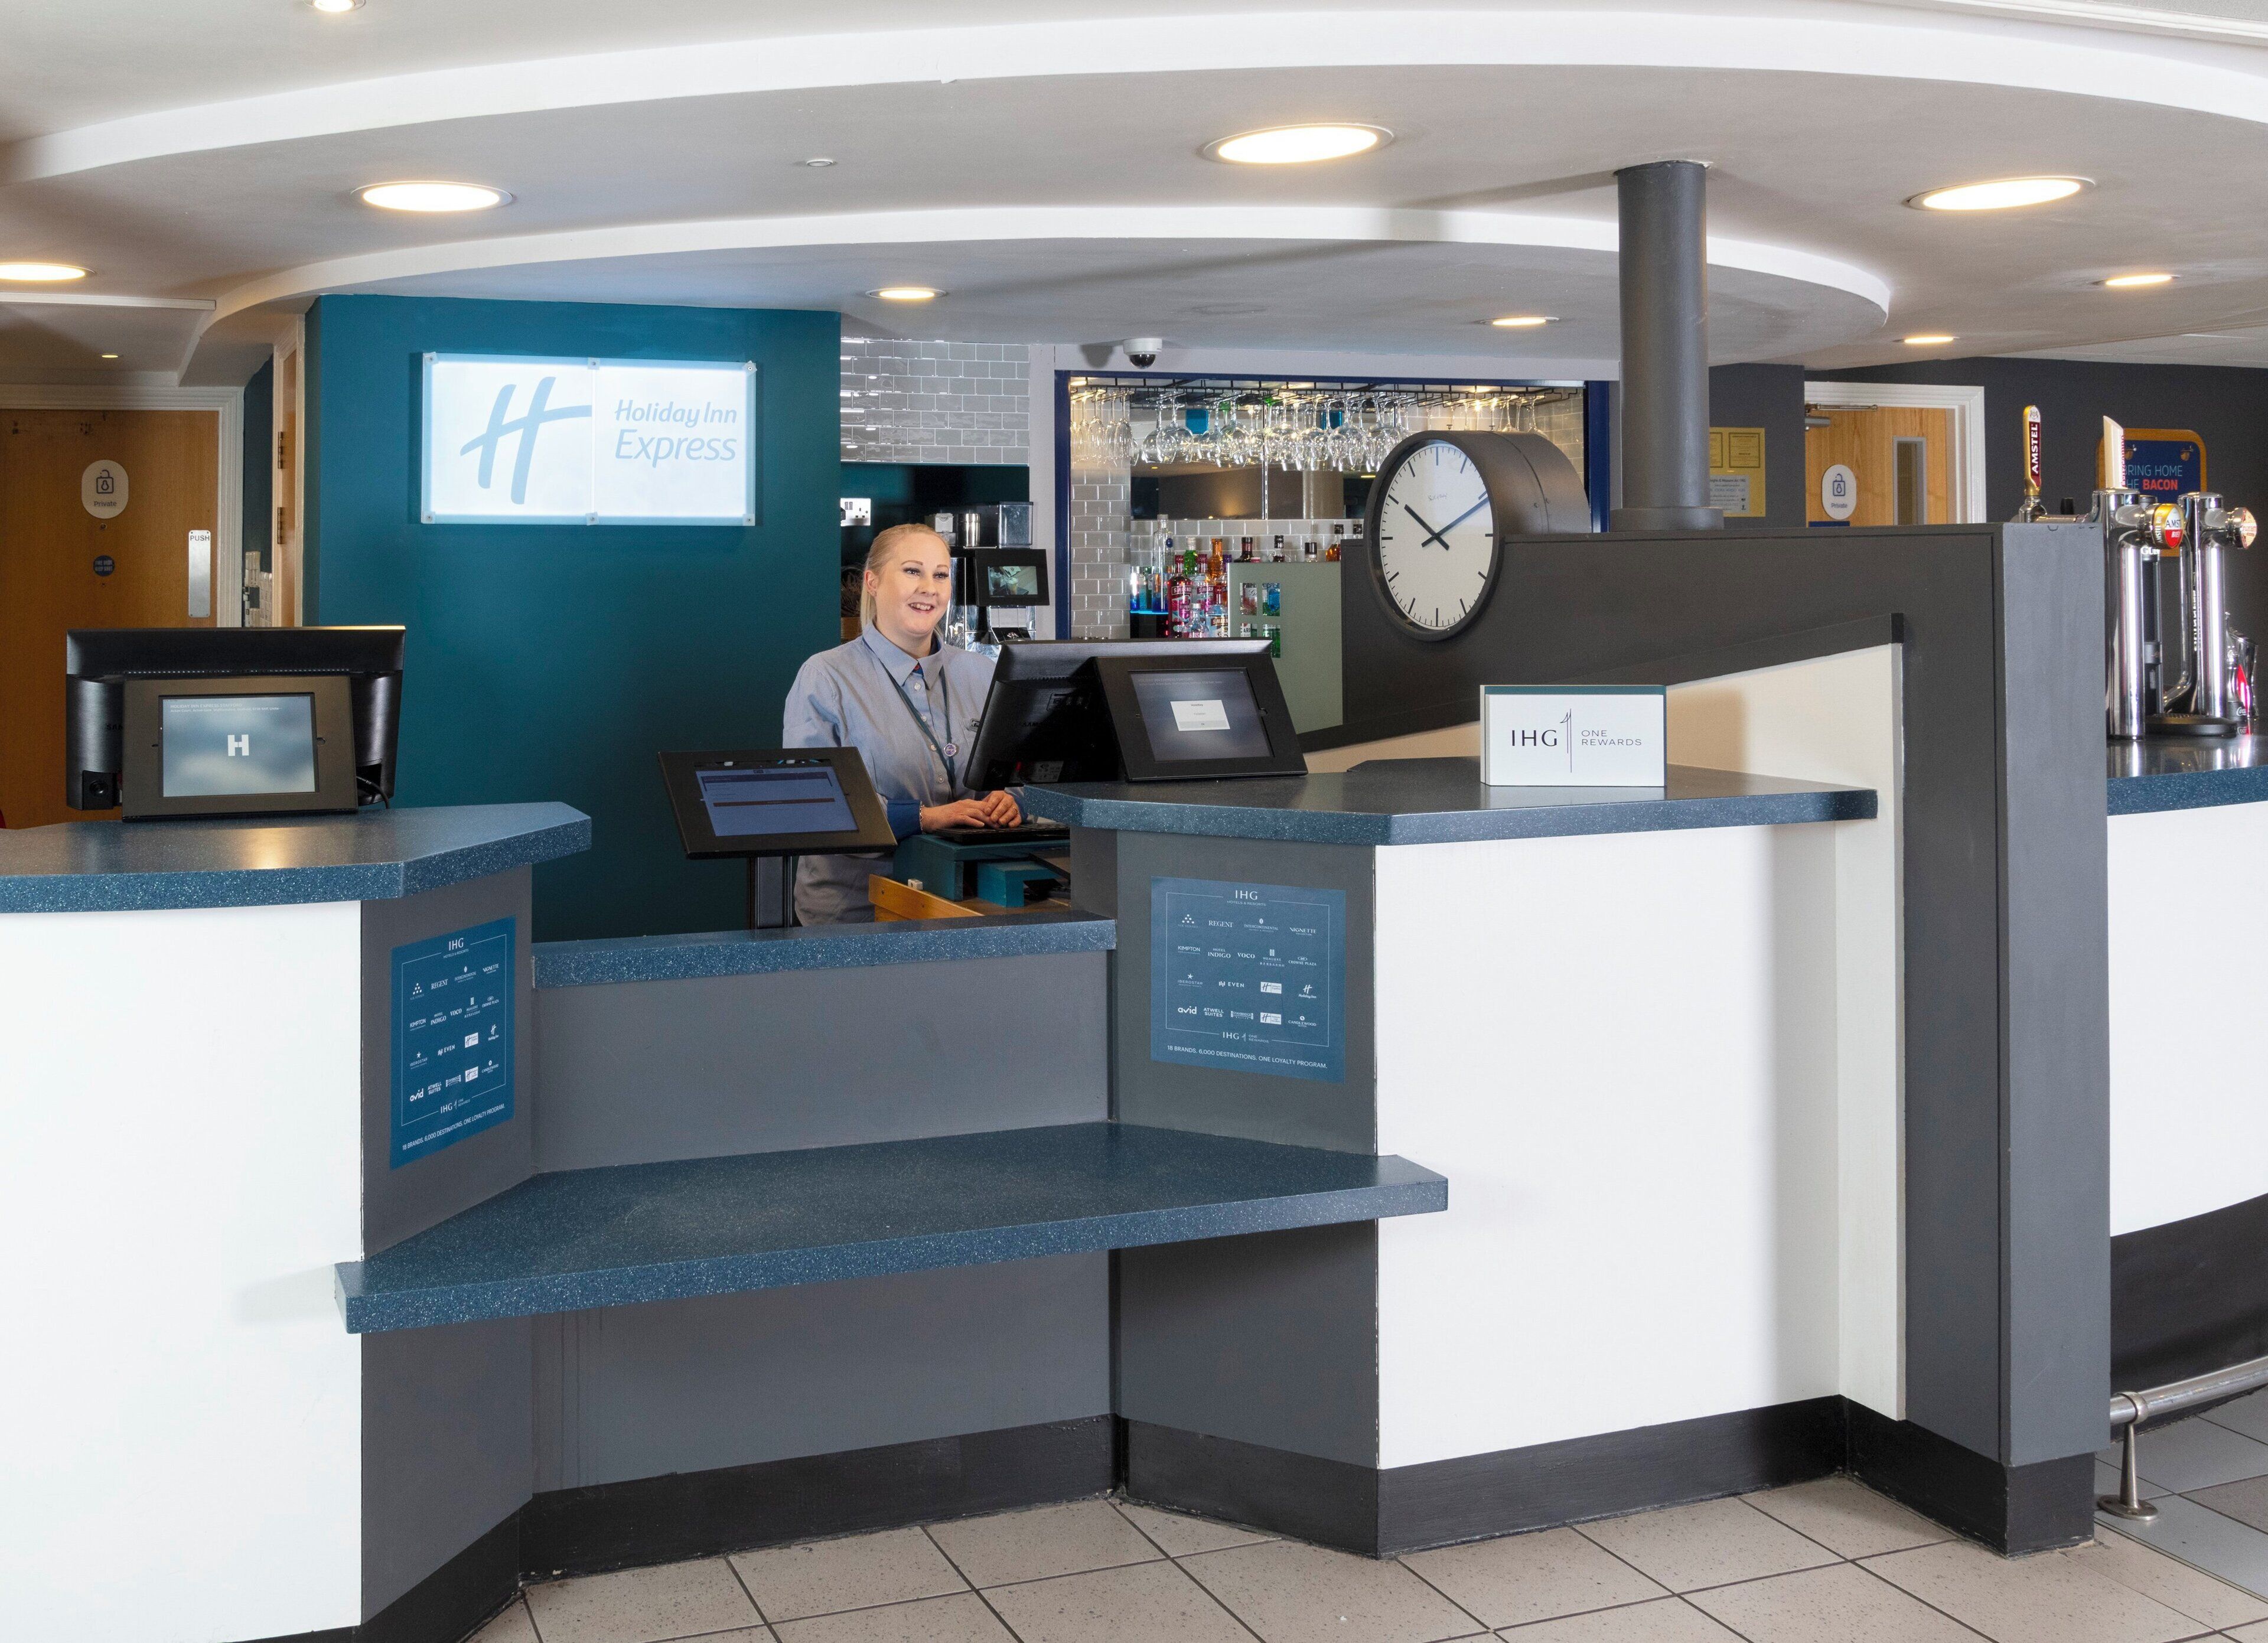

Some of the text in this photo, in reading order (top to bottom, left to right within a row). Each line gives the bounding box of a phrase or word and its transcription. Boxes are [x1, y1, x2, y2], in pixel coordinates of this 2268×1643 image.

[614, 399, 737, 428] Holiday Inn
[615, 429, 737, 468] Express
[2126, 465, 2182, 477] RING HOME
[2142, 479, 2178, 490] BACON
[1511, 729, 1557, 746] IHG
[227, 735, 249, 756] H
[1235, 889, 1258, 900] IHG
[449, 938, 464, 951] IHG
[431, 979, 448, 990] REGENT
[1178, 1006, 1197, 1015] avid
[410, 1018, 426, 1028] KIMPTON
[431, 1015, 447, 1025] INDIGO
[444, 1044, 455, 1053] EVEN
[1216, 1051, 1257, 1061] DESTINATIONS.
[1296, 1060, 1327, 1069] PROGRAM.
[428, 1081, 442, 1091] ATWELL
[428, 1086, 441, 1095] SUITES
[410, 1088, 424, 1102] avid
[441, 1103, 452, 1114] IHG
[407, 1138, 424, 1149] BRANDS.
[424, 1132, 436, 1141] 6,000
[436, 1121, 463, 1137] DESTINATIONS.
[471, 1110, 487, 1121] LOYALTY
[487, 1103, 506, 1116] PROGRAM.
